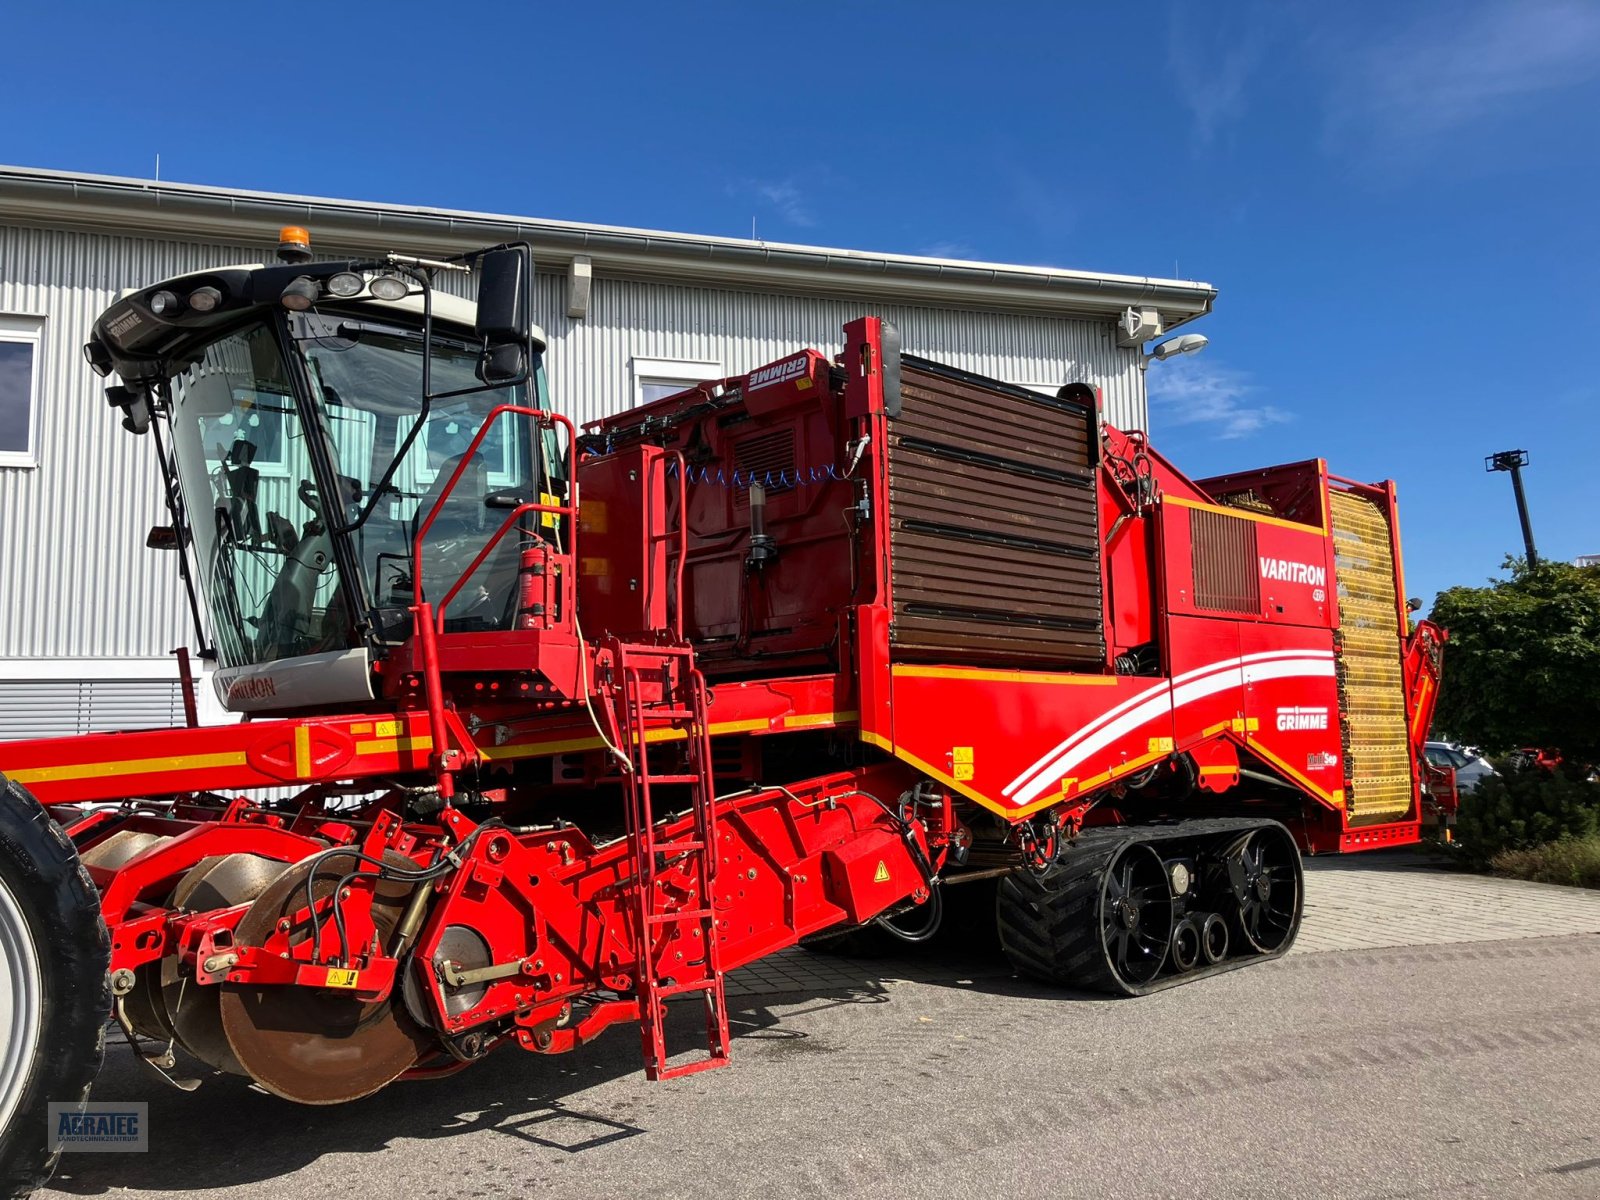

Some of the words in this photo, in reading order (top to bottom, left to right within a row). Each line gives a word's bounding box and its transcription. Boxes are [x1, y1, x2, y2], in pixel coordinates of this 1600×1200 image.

[748, 357, 807, 389] GRIMME
[1260, 556, 1325, 587] VARITRON
[1276, 707, 1328, 731] GRIMME
